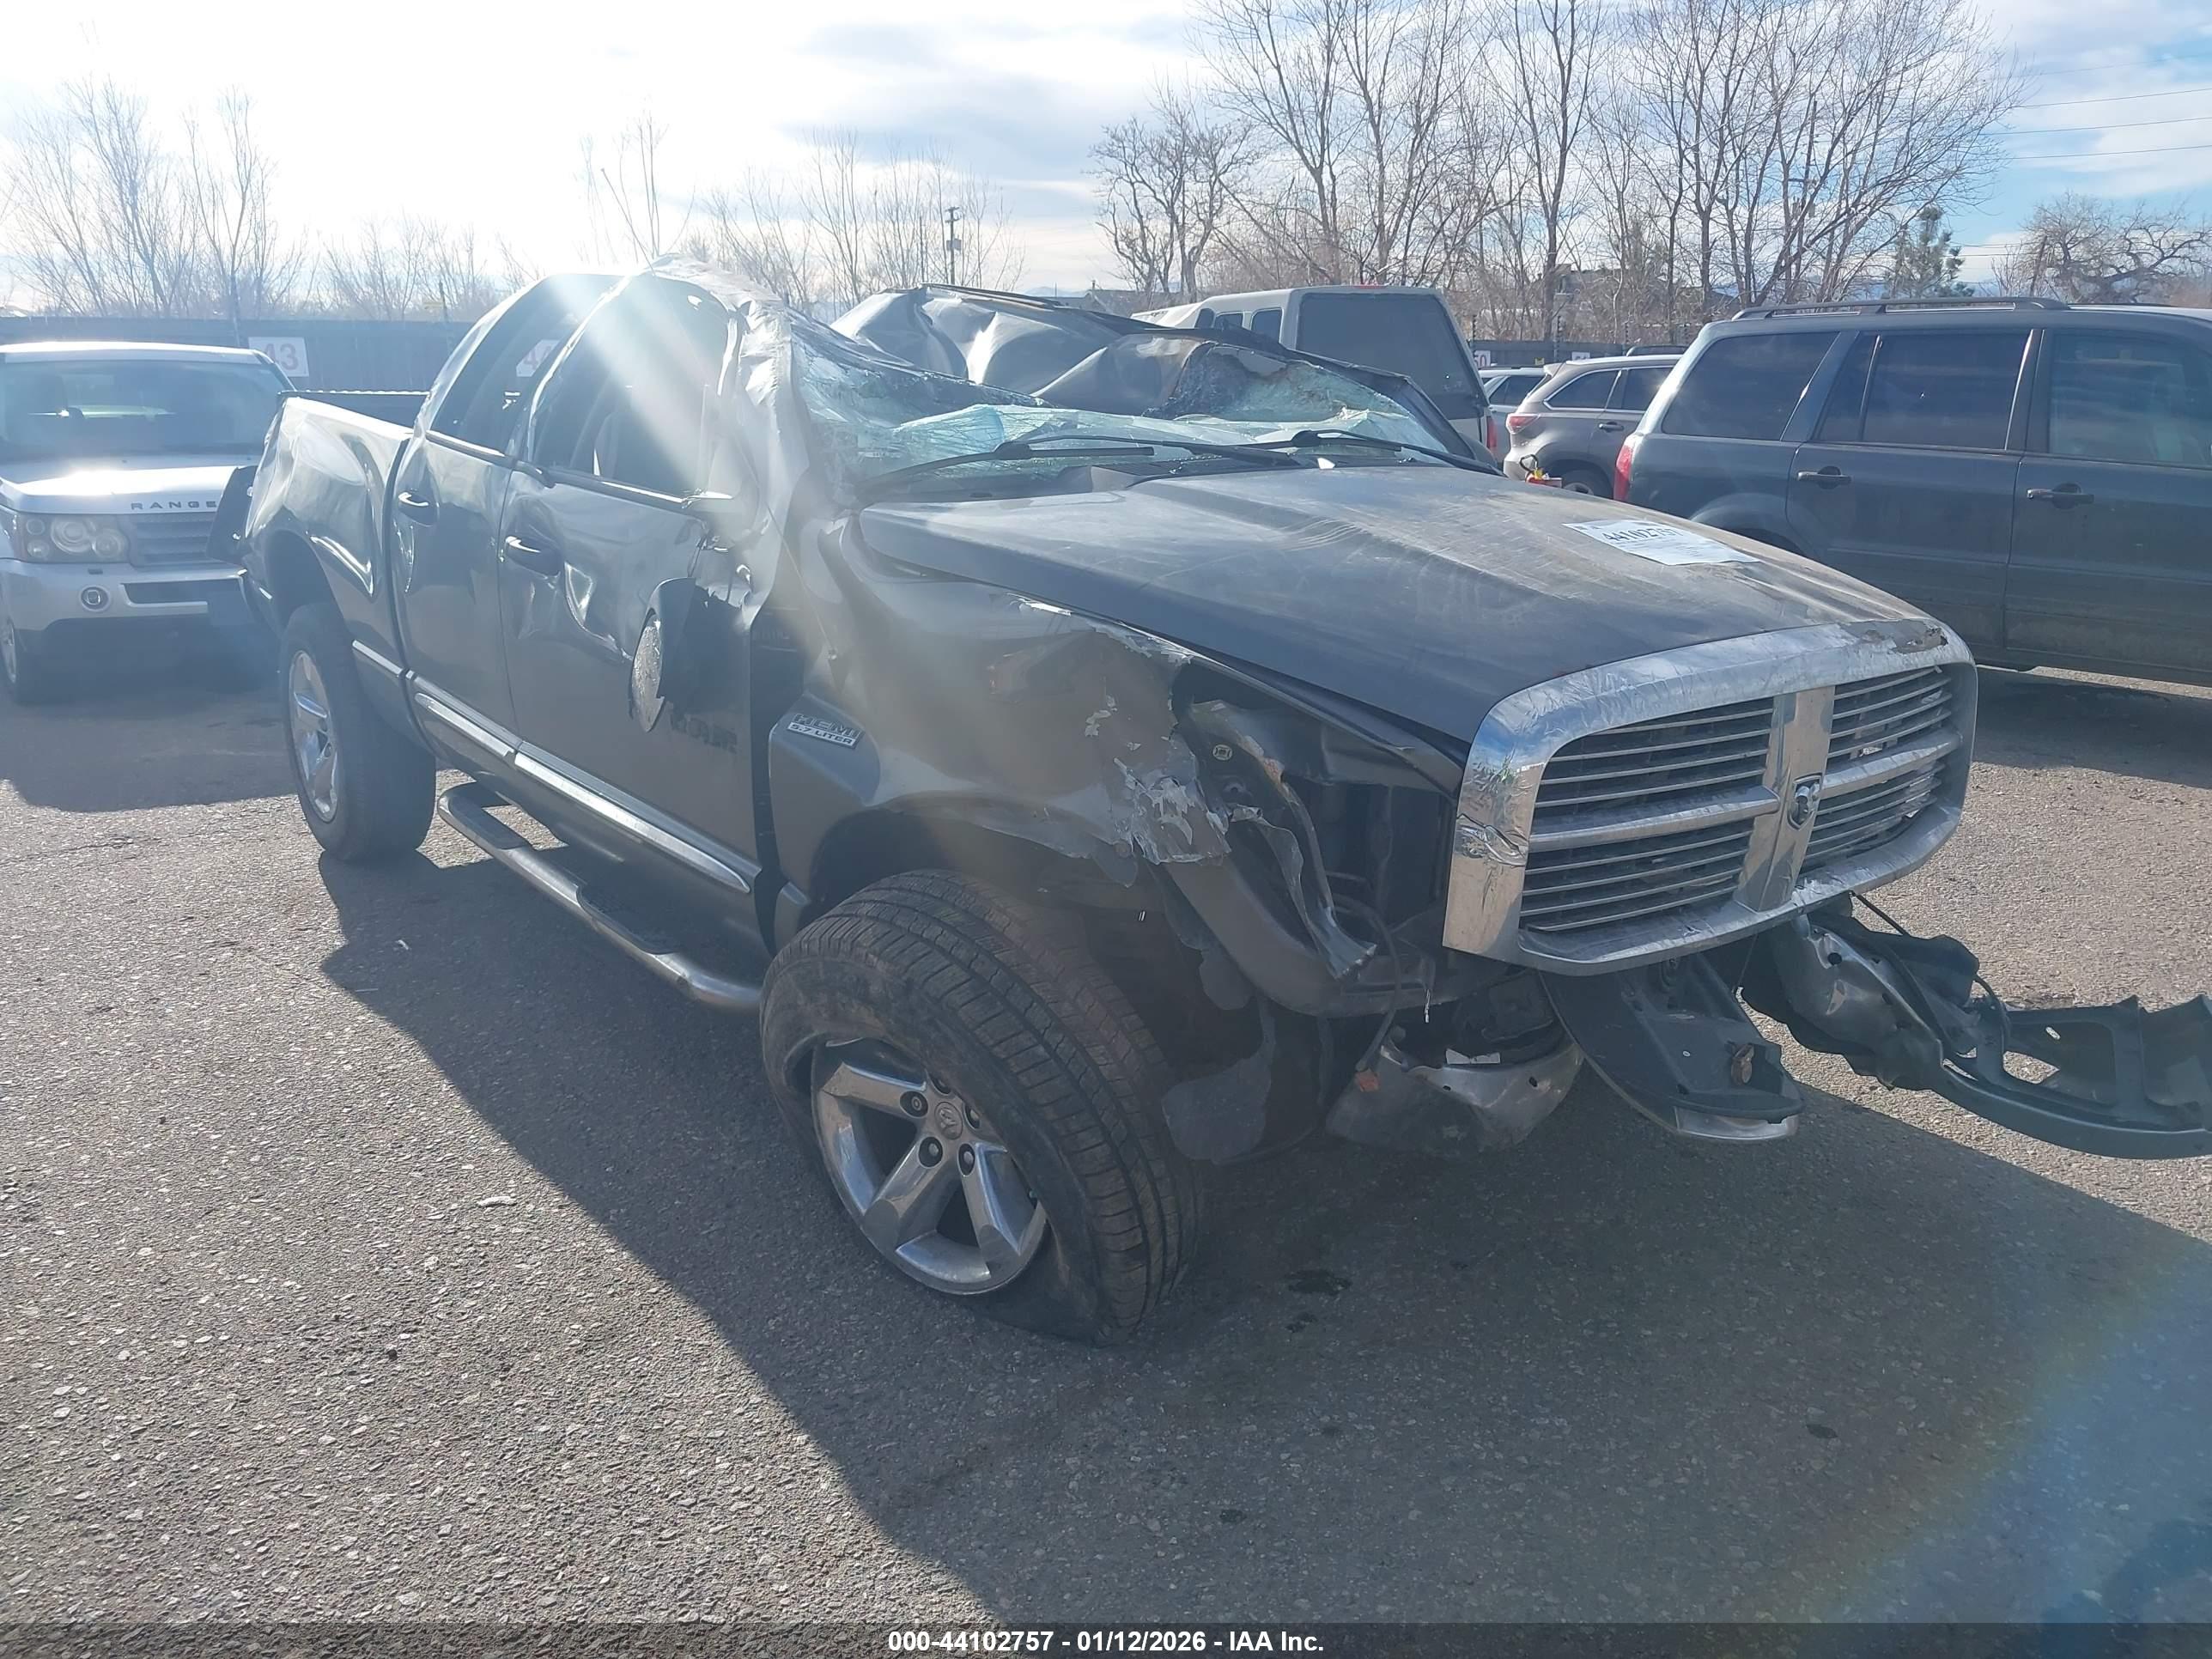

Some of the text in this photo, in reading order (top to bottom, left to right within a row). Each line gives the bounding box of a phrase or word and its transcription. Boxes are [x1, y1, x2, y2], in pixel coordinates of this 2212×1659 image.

[131, 501, 217, 510] RANGE
[790, 723, 854, 744] 5.7 LITER
[791, 713, 861, 739] HEMI
